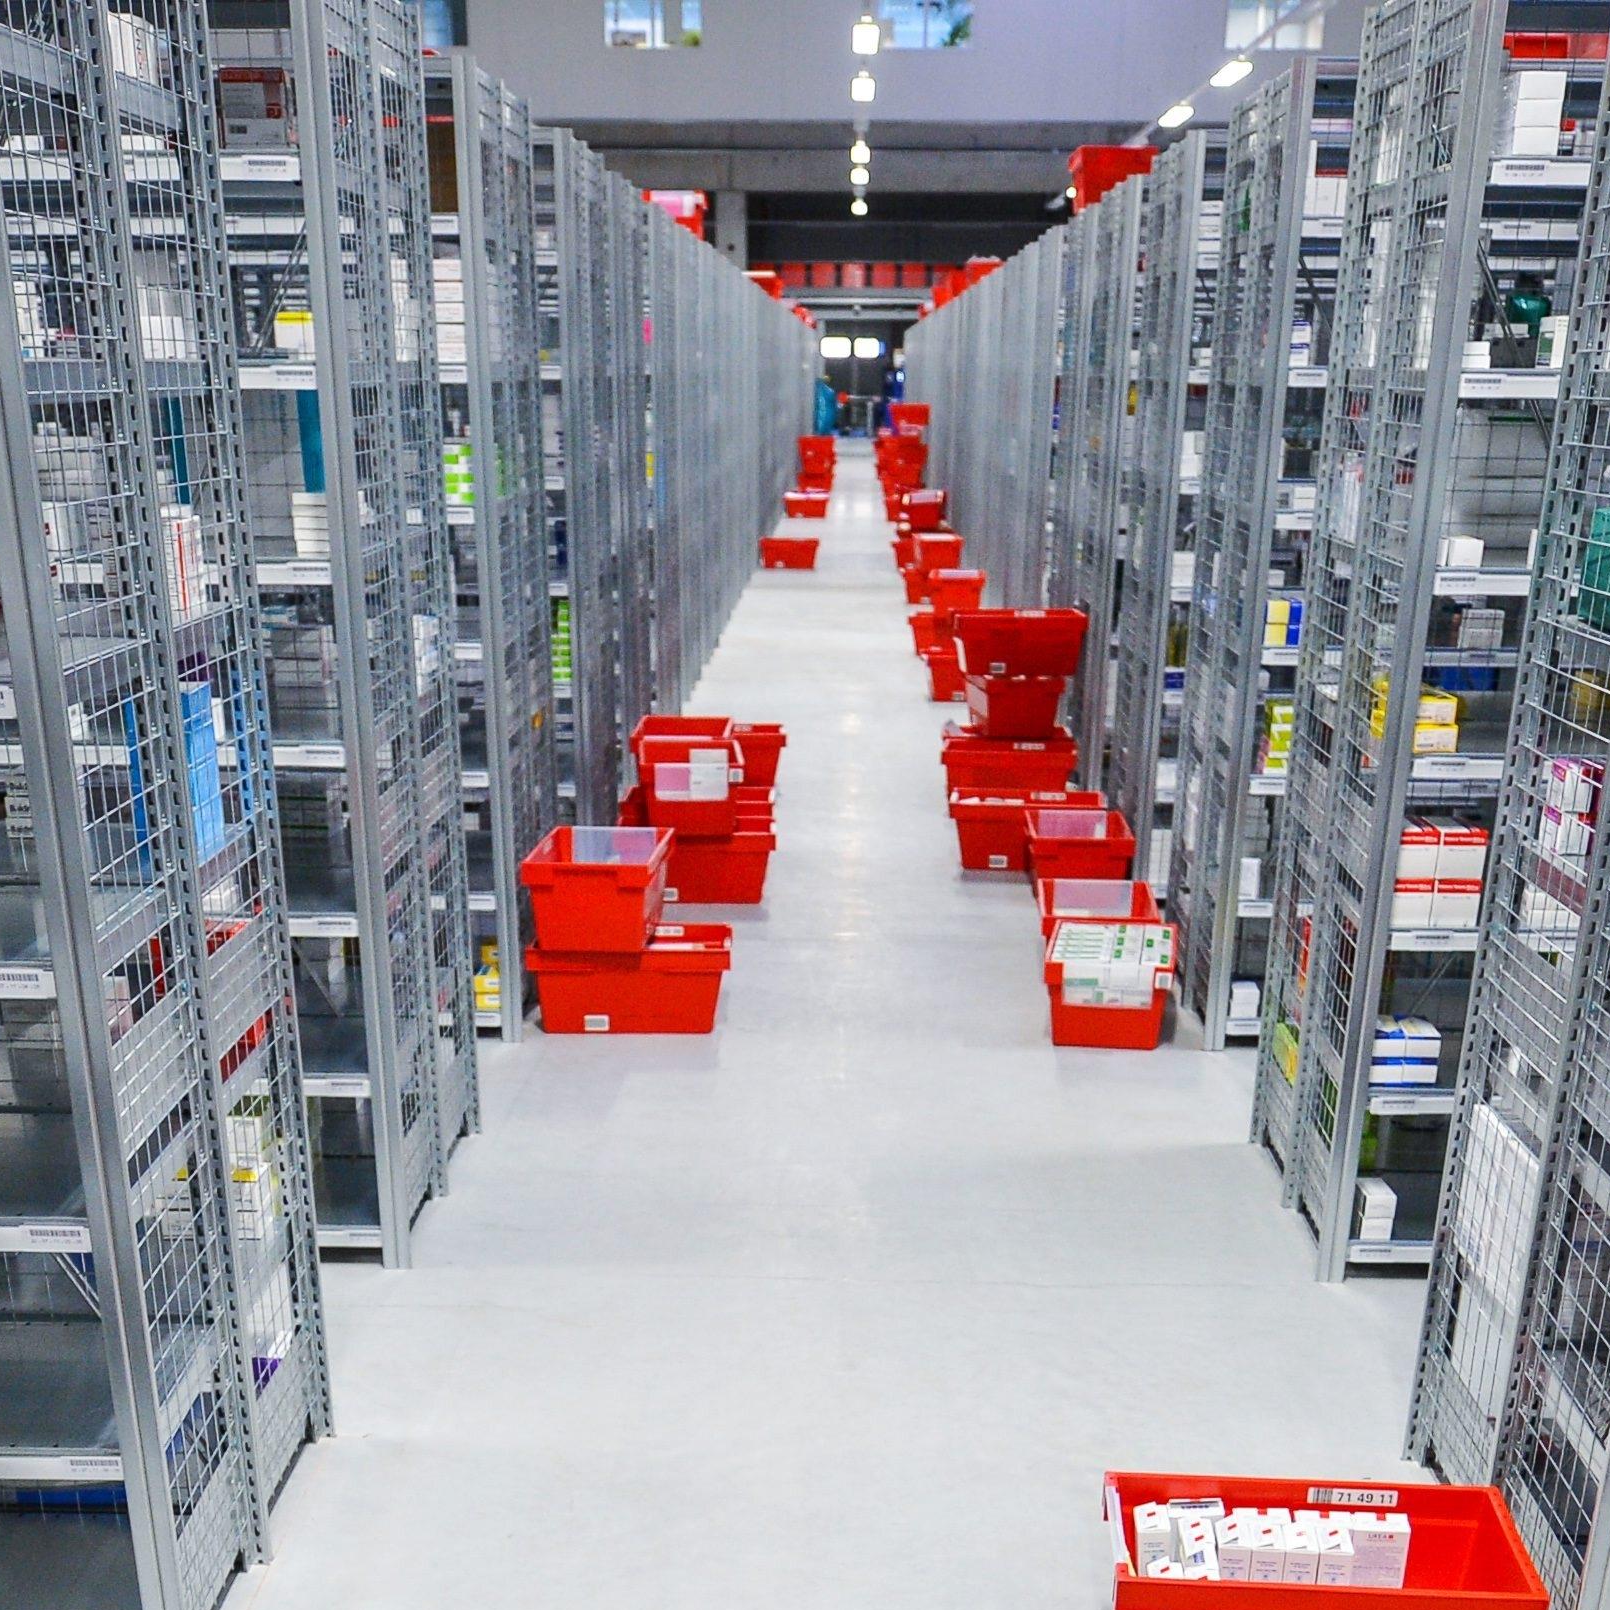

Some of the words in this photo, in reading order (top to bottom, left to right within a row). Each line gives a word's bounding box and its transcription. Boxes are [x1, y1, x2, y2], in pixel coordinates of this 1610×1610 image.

[1337, 1492, 1352, 1503] 71
[1357, 1493, 1374, 1504] 49
[1380, 1494, 1394, 1504] 11
